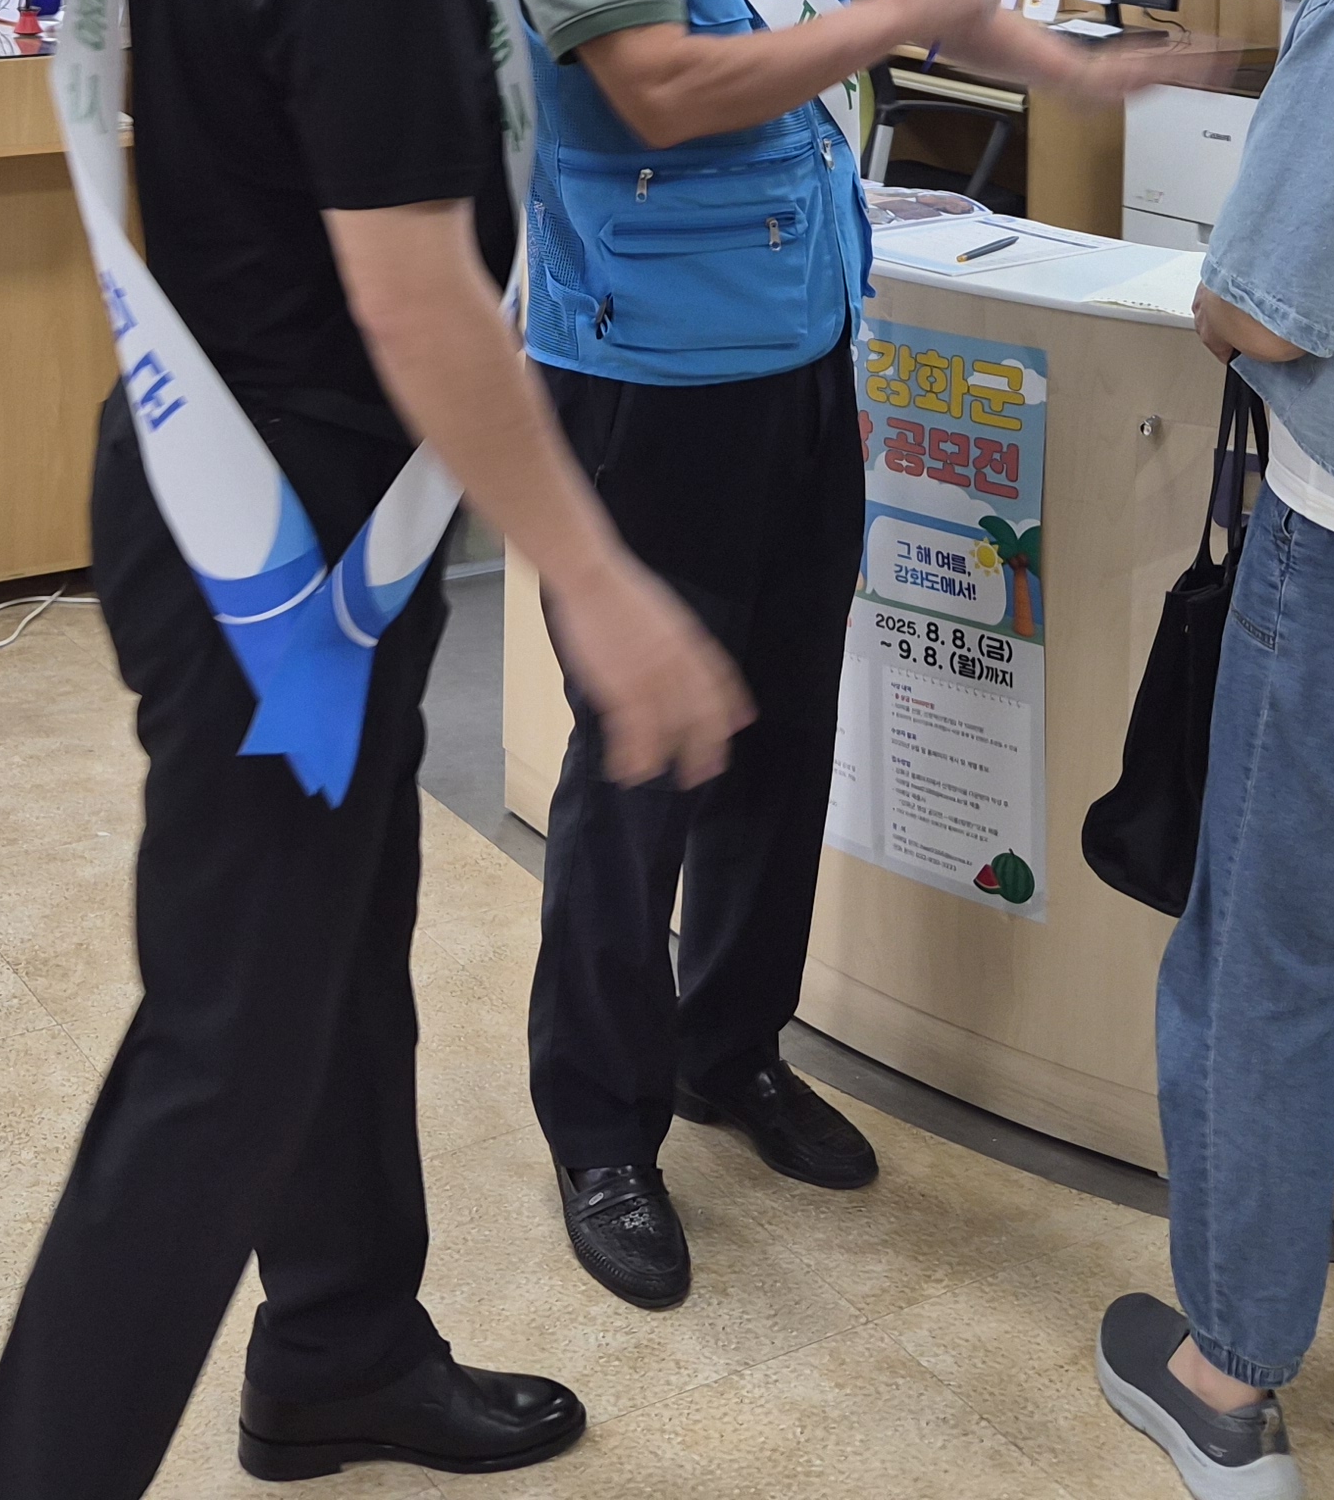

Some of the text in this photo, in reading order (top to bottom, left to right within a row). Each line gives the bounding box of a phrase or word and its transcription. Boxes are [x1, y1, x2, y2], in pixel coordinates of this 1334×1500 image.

[866, 338, 1025, 431] 강화군
[884, 416, 1020, 500] 공모전
[893, 563, 977, 601] 강화도에서!
[896, 540, 972, 578] 그 해 여름,
[875, 613, 1013, 663] 2025. 8. 8. (금)
[923, 645, 943, 669] 8.
[949, 654, 1014, 688] (월)까지
